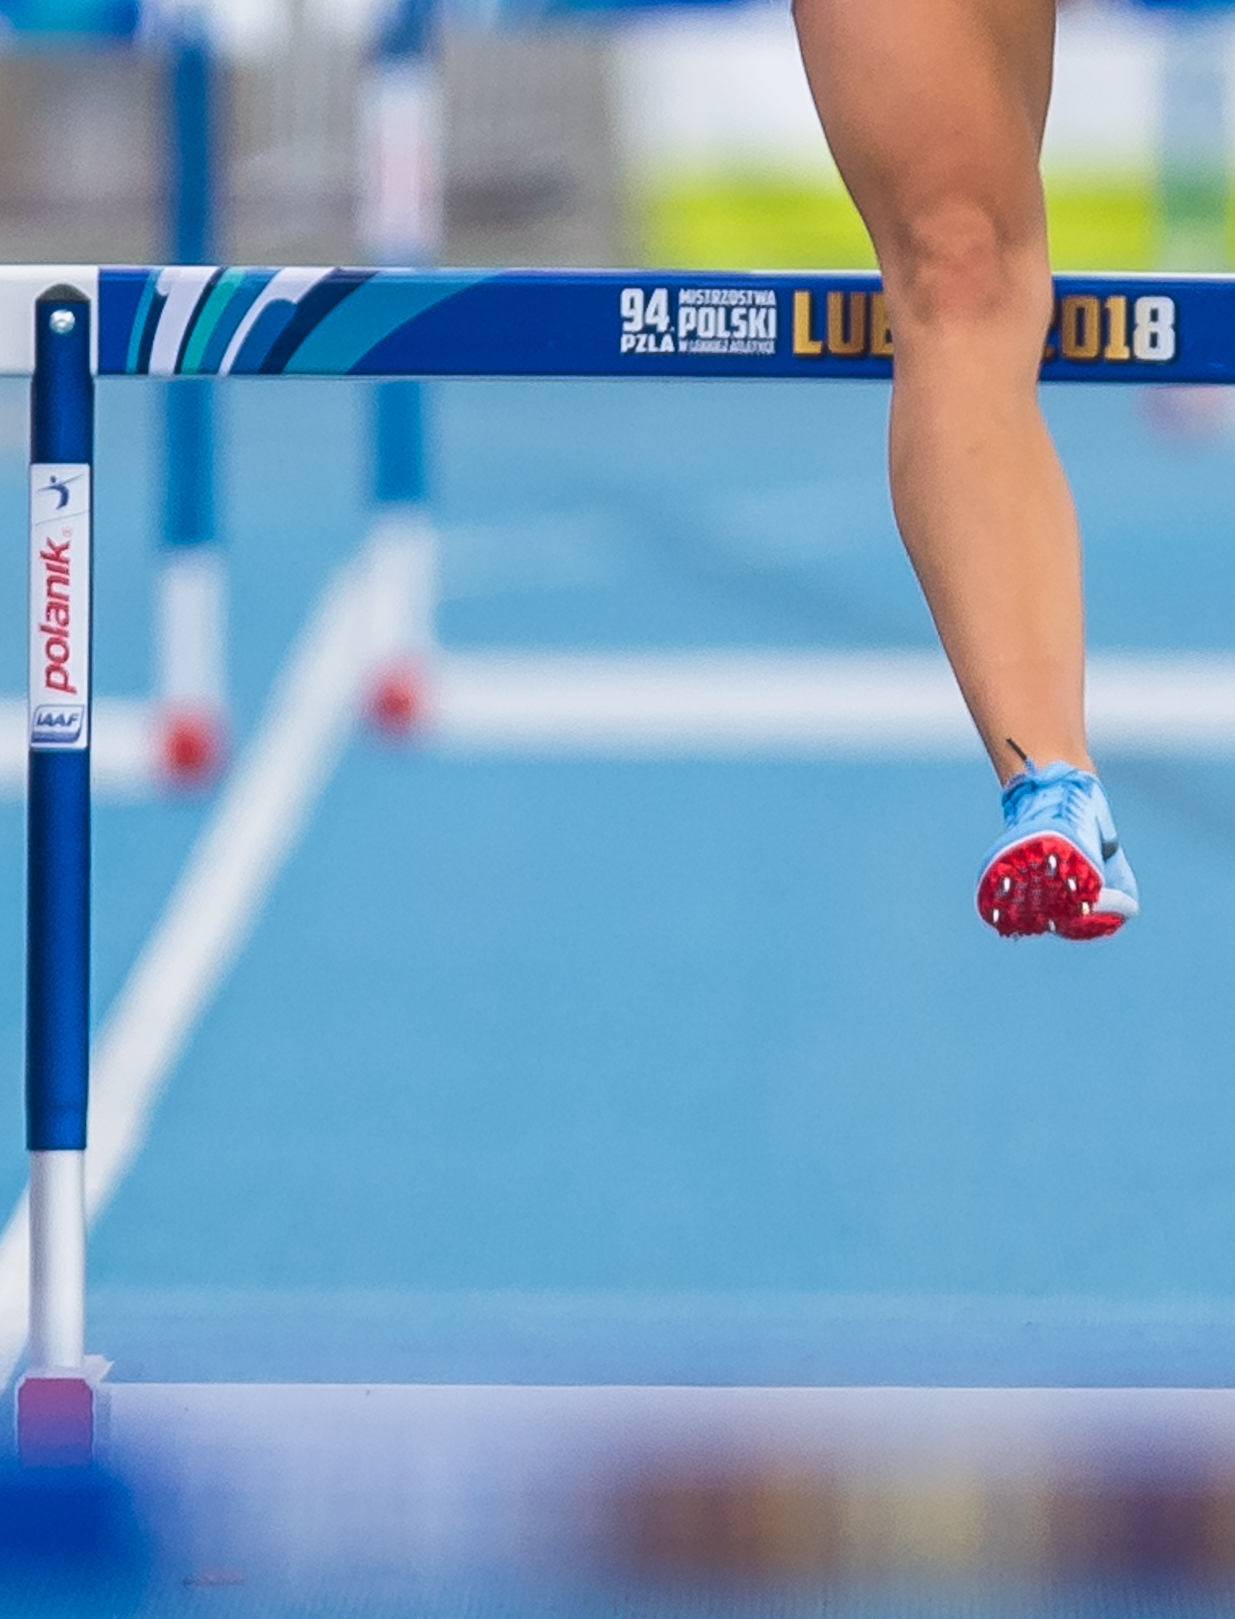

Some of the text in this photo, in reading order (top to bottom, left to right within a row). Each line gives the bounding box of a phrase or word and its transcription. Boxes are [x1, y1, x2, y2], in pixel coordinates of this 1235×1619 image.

[678, 306, 778, 339] POLSKI
[1044, 295, 1177, 361] 018
[620, 333, 675, 353] PZLA
[38, 536, 78, 695] polanik
[36, 712, 80, 727] IAAF
